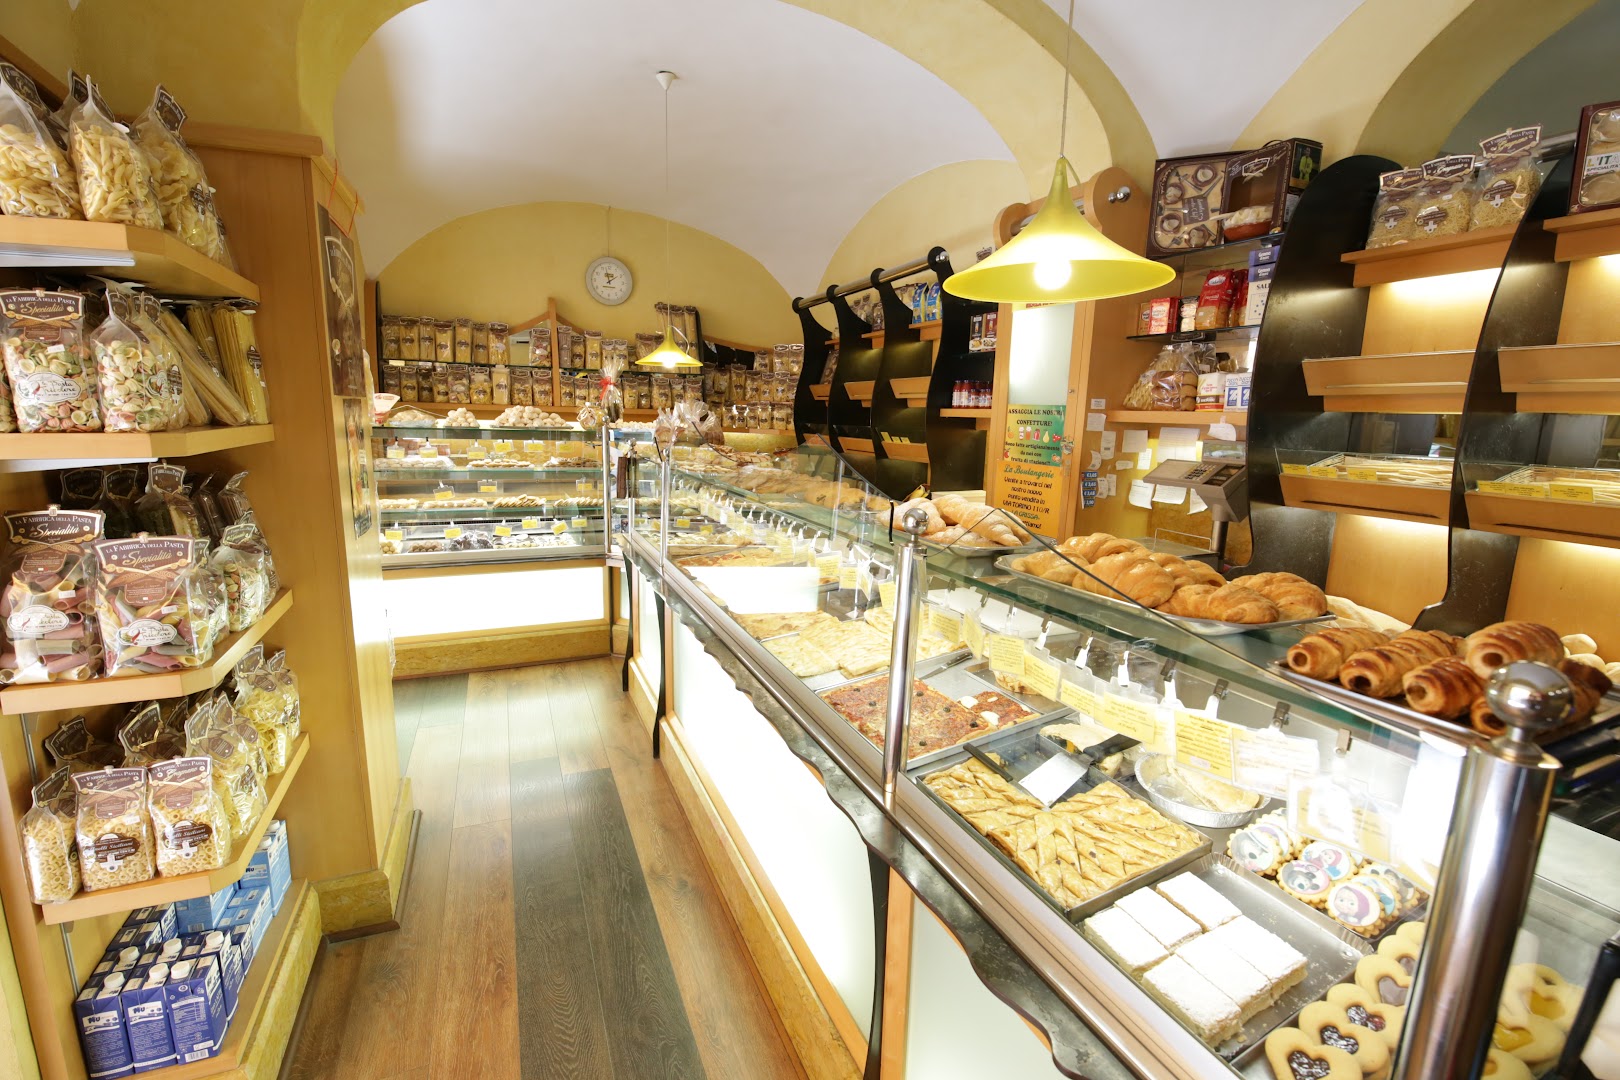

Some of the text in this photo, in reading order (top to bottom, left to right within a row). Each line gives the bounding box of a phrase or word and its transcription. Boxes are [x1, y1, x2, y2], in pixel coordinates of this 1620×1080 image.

[1014, 465, 1054, 479] Boulangerie
[1012, 501, 1031, 510] TORINO
[29, 524, 79, 539] Specialità
[113, 543, 146, 551] FABBRICA
[122, 550, 172, 567] Specialità
